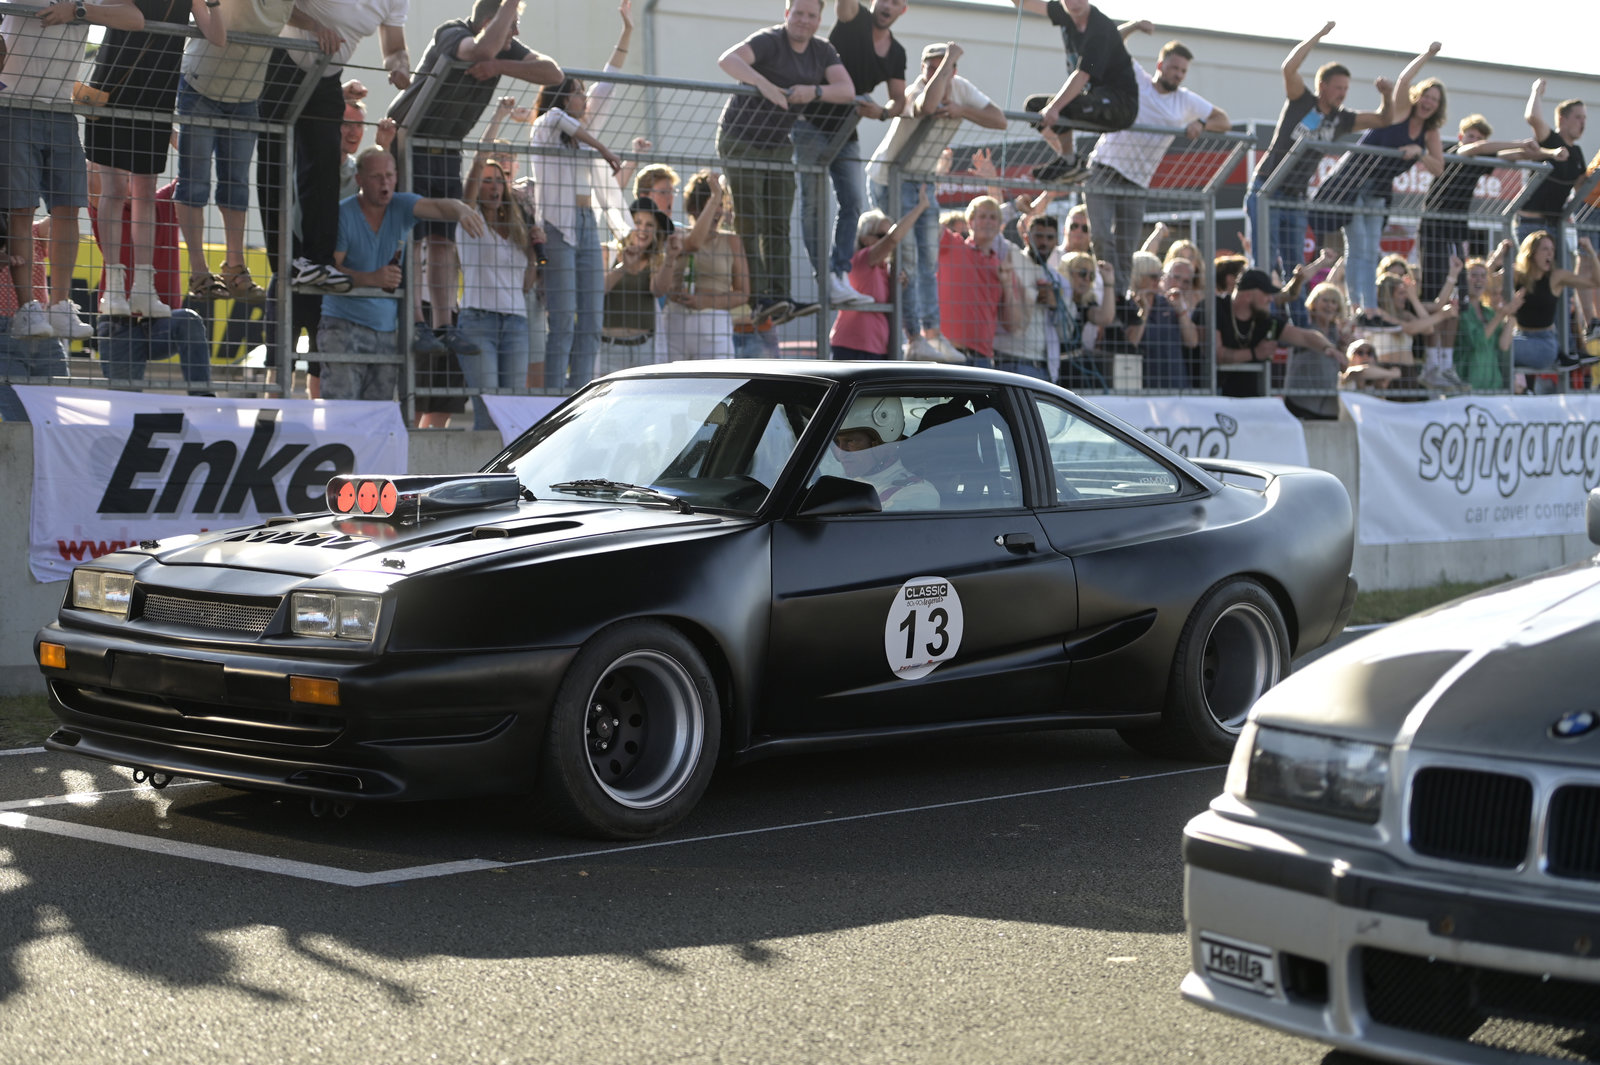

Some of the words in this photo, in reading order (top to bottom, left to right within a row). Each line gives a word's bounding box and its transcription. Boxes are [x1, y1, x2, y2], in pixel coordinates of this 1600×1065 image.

[96, 408, 356, 514] Enke
[1465, 506, 1489, 523] car
[1494, 503, 1530, 522] cover
[906, 585, 946, 598] CLASSIC
[900, 609, 949, 658] 13
[1210, 944, 1263, 977] Hella
